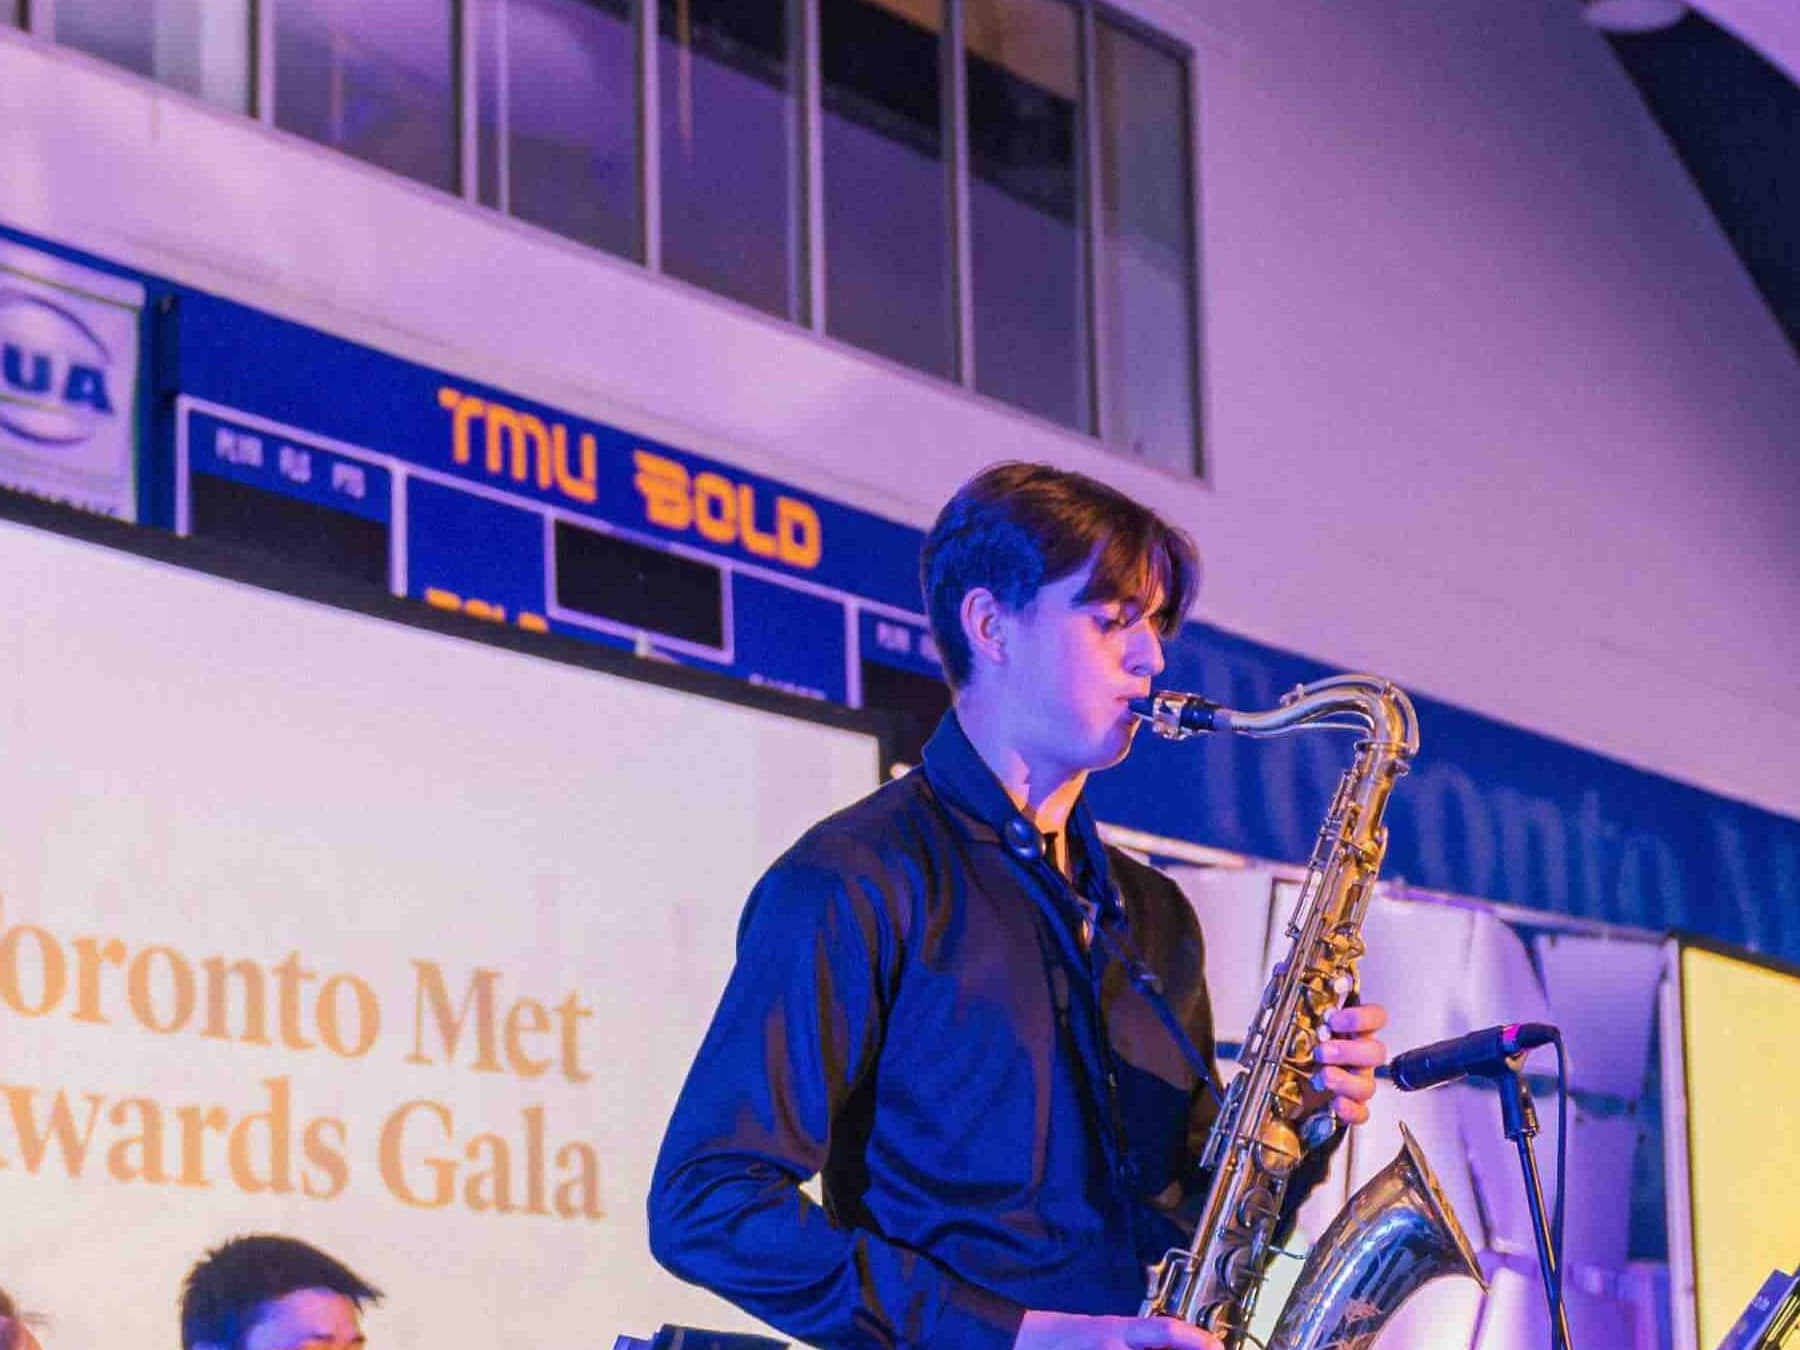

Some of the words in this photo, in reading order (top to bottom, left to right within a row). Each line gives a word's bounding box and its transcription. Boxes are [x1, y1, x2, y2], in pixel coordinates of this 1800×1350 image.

[436, 386, 598, 504] TMU
[632, 448, 823, 570] BOLD
[404, 957, 594, 1084] Met
[376, 1098, 607, 1222] Gala
